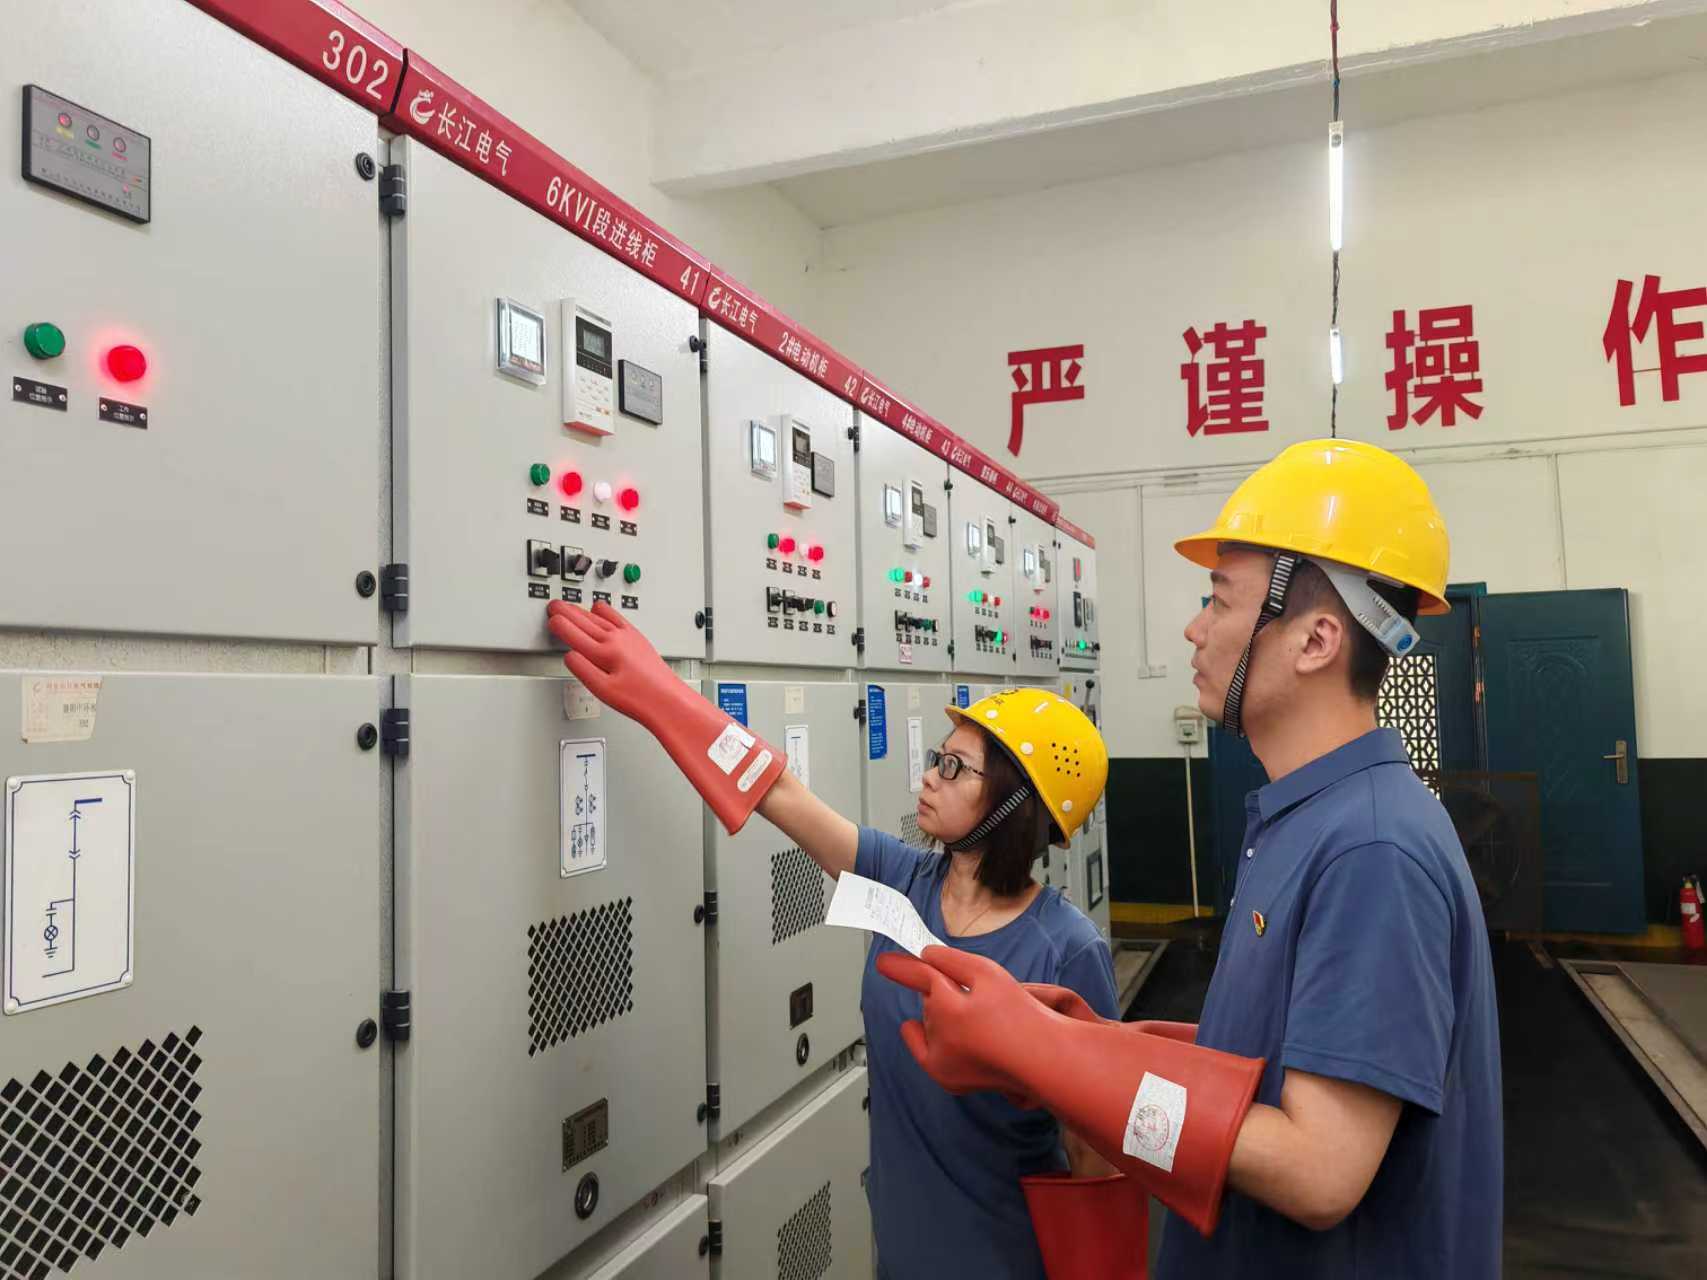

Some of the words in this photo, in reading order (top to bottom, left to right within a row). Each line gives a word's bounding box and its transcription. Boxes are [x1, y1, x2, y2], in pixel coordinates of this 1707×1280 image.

[322, 29, 389, 100] 302
[437, 102, 512, 176] 长江电气
[680, 265, 700, 296] 41
[720, 291, 758, 333] 长江电气
[778, 332, 828, 377] 2#电动机柜
[844, 375, 858, 398] 42
